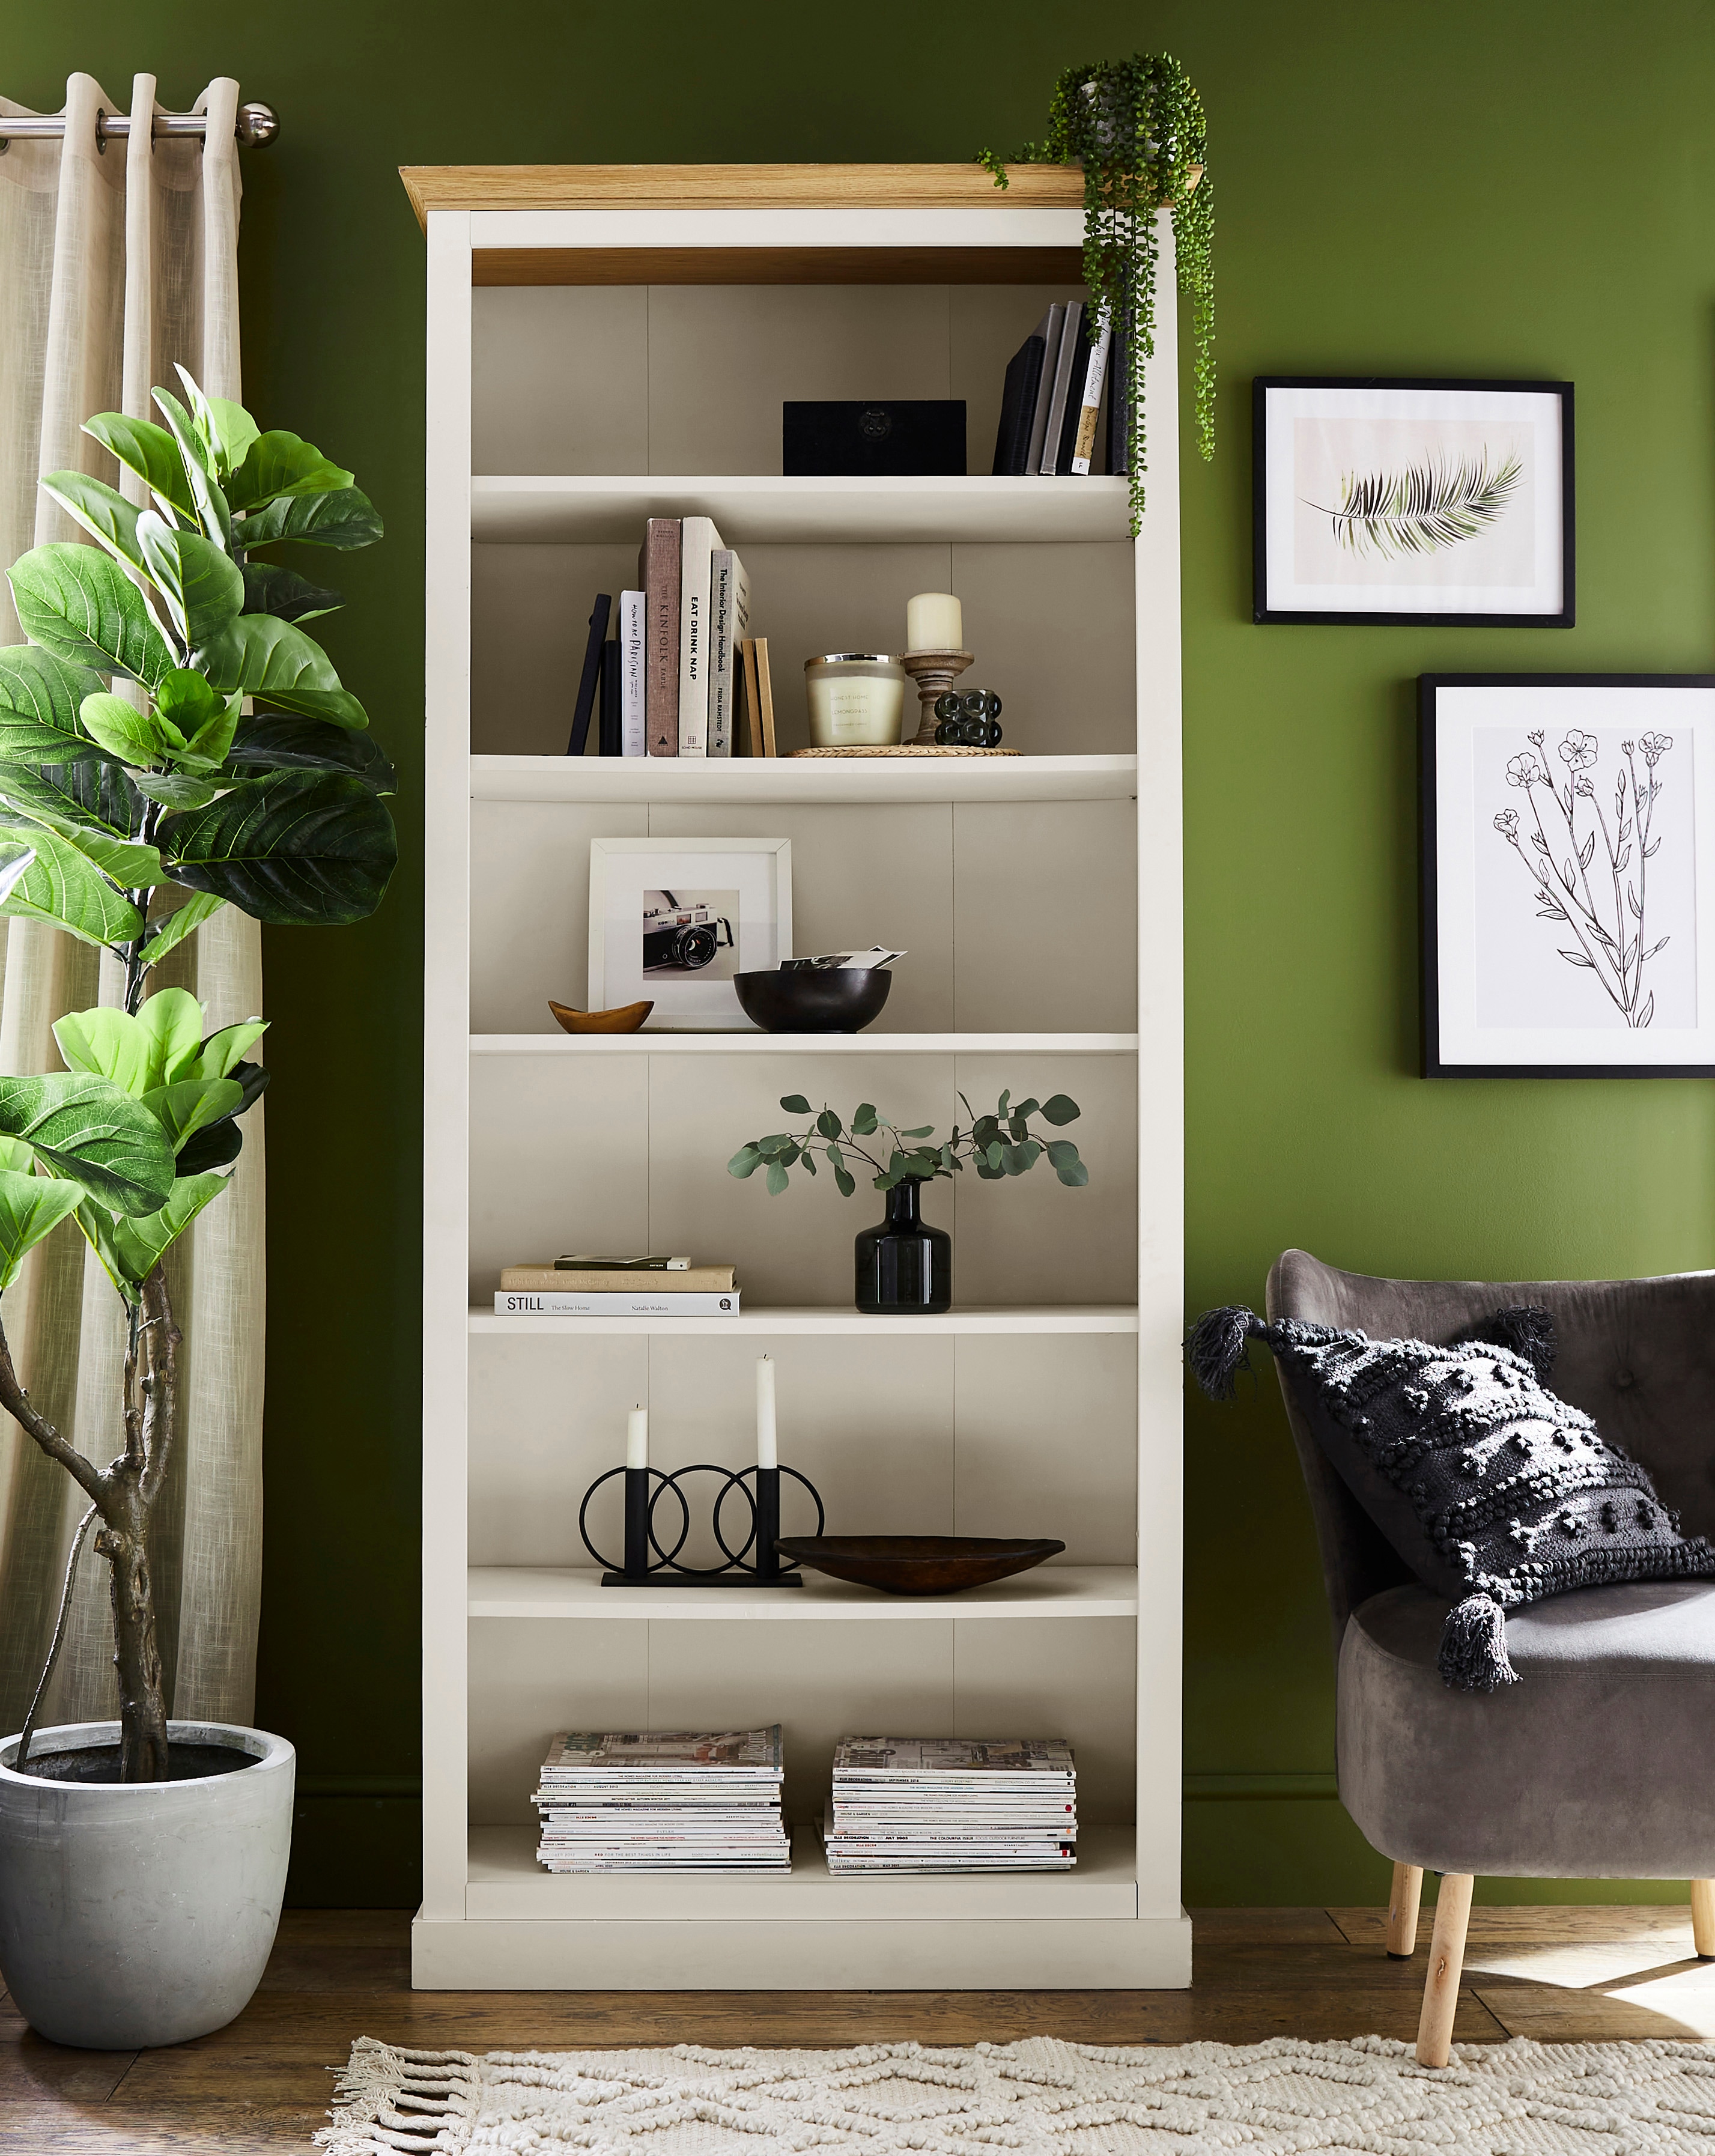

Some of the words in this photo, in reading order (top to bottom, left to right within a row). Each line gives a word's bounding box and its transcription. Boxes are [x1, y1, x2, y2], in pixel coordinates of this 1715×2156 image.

[718, 583, 727, 609] Interior
[660, 604, 669, 663] KINFOLK
[690, 621, 699, 654] DRINK
[717, 610, 726, 634] Design
[628, 640, 642, 678] PARISIAN
[717, 636, 726, 672] Handbook
[507, 1297, 544, 1310] STILL
[737, 1729, 774, 1761] Elegant
